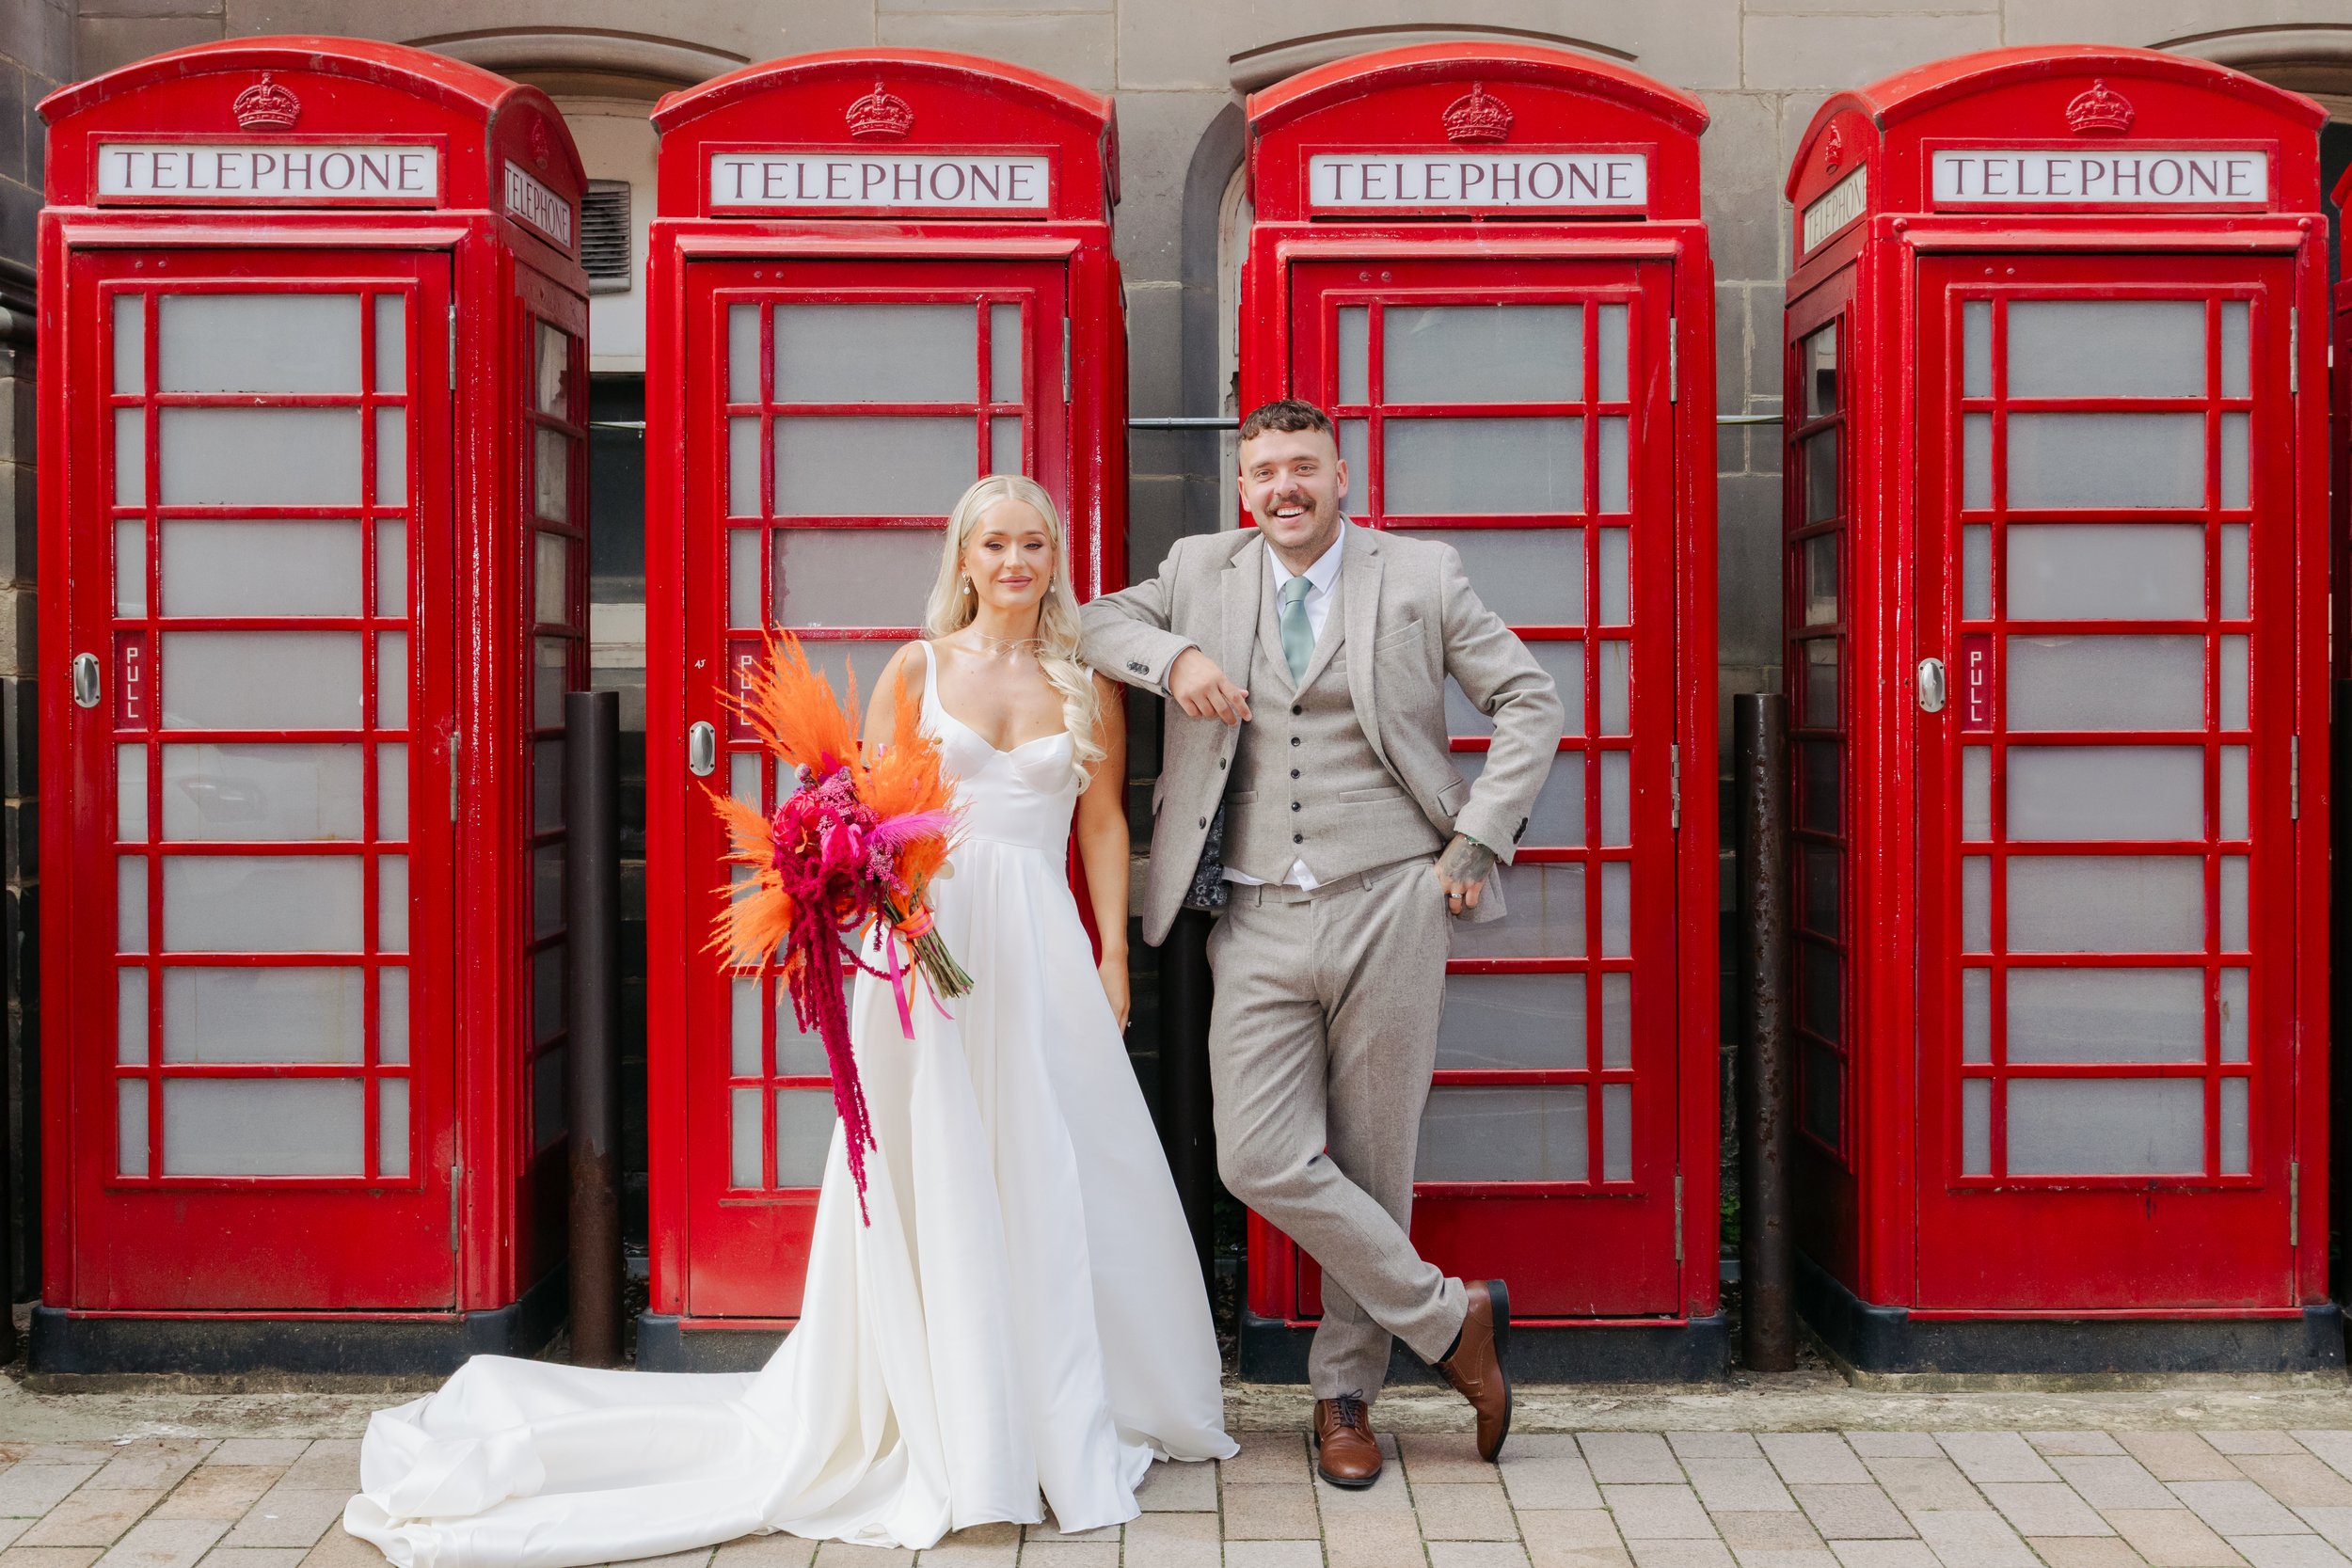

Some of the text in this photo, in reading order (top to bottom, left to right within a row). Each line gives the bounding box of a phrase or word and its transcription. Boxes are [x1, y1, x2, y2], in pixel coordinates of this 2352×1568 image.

[113, 151, 425, 190] TELEPHONE
[723, 162, 1036, 200] TELEPHONE
[1323, 162, 1634, 199] TELEPHONE
[1945, 158, 2253, 197] TELEPHONE
[504, 166, 568, 244] TELEPHONE
[126, 647, 139, 719] PULL
[739, 655, 753, 726] PULL
[1970, 651, 1982, 721] PULL
